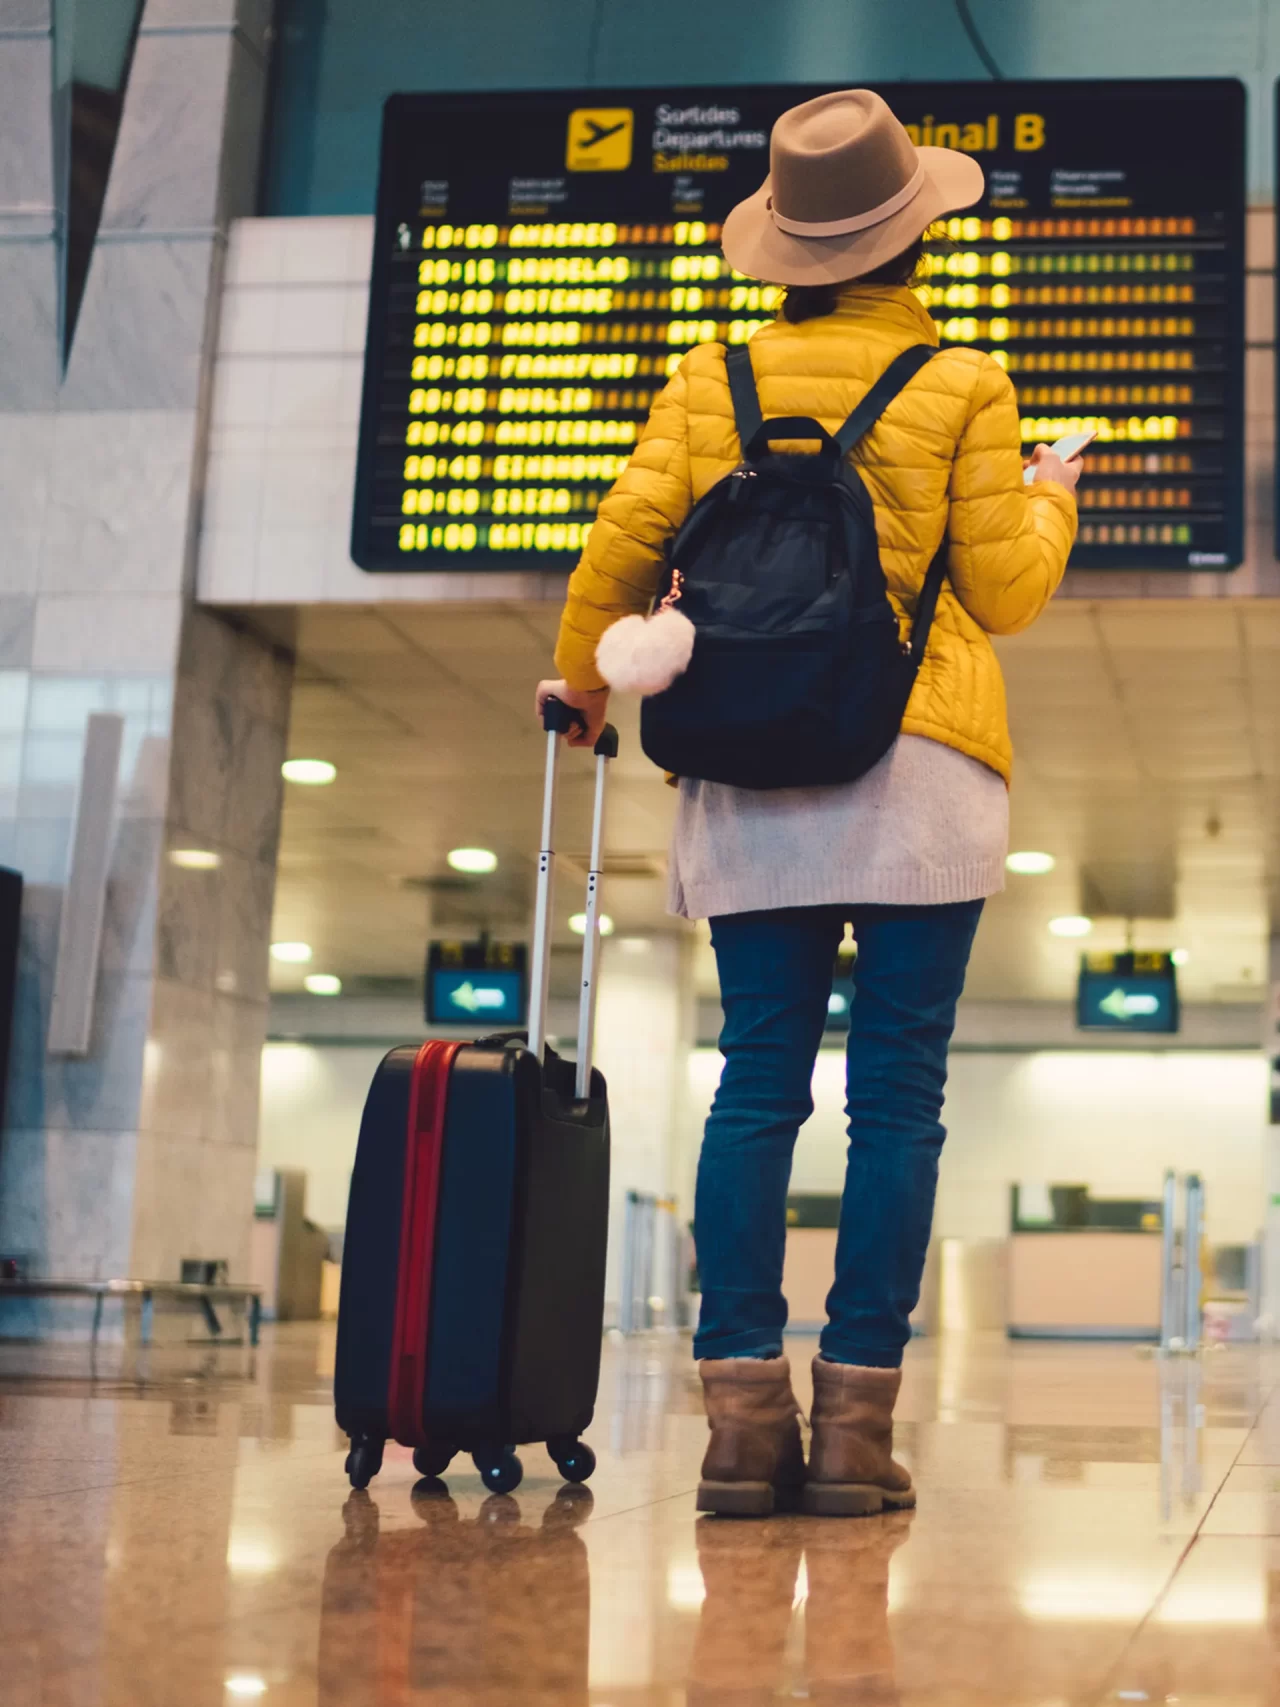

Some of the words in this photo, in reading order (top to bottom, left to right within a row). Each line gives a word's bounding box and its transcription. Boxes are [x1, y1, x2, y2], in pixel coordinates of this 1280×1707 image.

[652, 127, 767, 150] Departures
[1014, 113, 1046, 151] B
[490, 487, 573, 515] IBIZA
